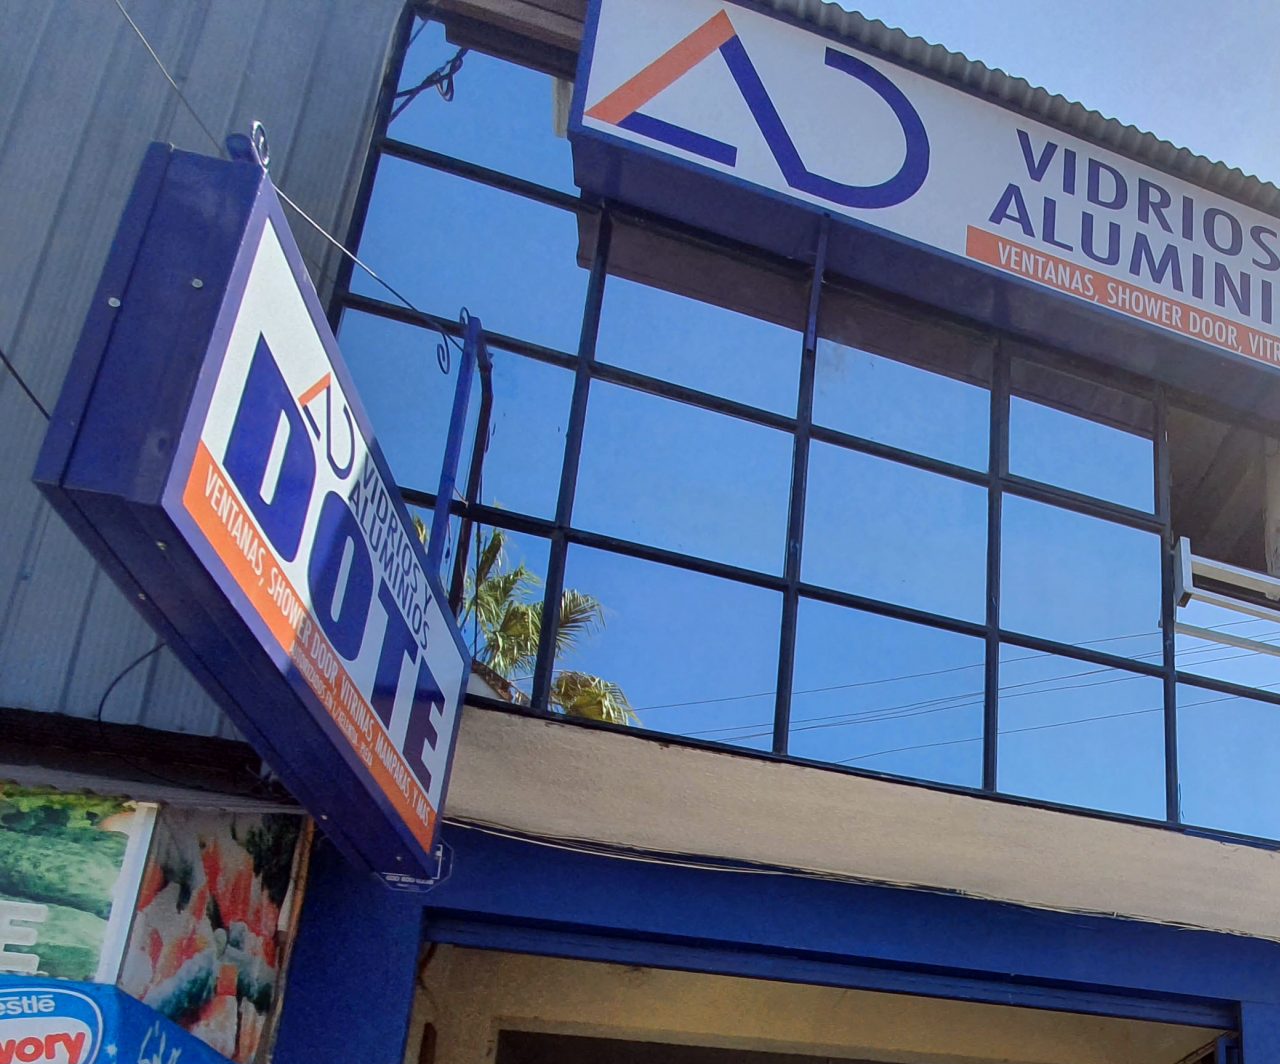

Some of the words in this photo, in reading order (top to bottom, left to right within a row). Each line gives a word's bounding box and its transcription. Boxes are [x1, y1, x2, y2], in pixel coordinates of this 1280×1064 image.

[1016, 128, 1280, 272] VIDRIOS
[998, 242, 1099, 302] VENTANAS,
[1107, 282, 1182, 328] SHOWER
[1189, 312, 1242, 353] DOOR,
[223, 331, 447, 784] DOTE
[348, 480, 430, 650] ALUMINIOS
[363, 451, 420, 593] VIDRIOS
[424, 584, 433, 615] Y
[204, 464, 266, 586] VENTANAS,
[267, 567, 312, 648] SHOWER
[310, 631, 340, 692] DOOR,
[341, 673, 375, 748] VITRINAS,
[412, 791, 419, 808] Y
